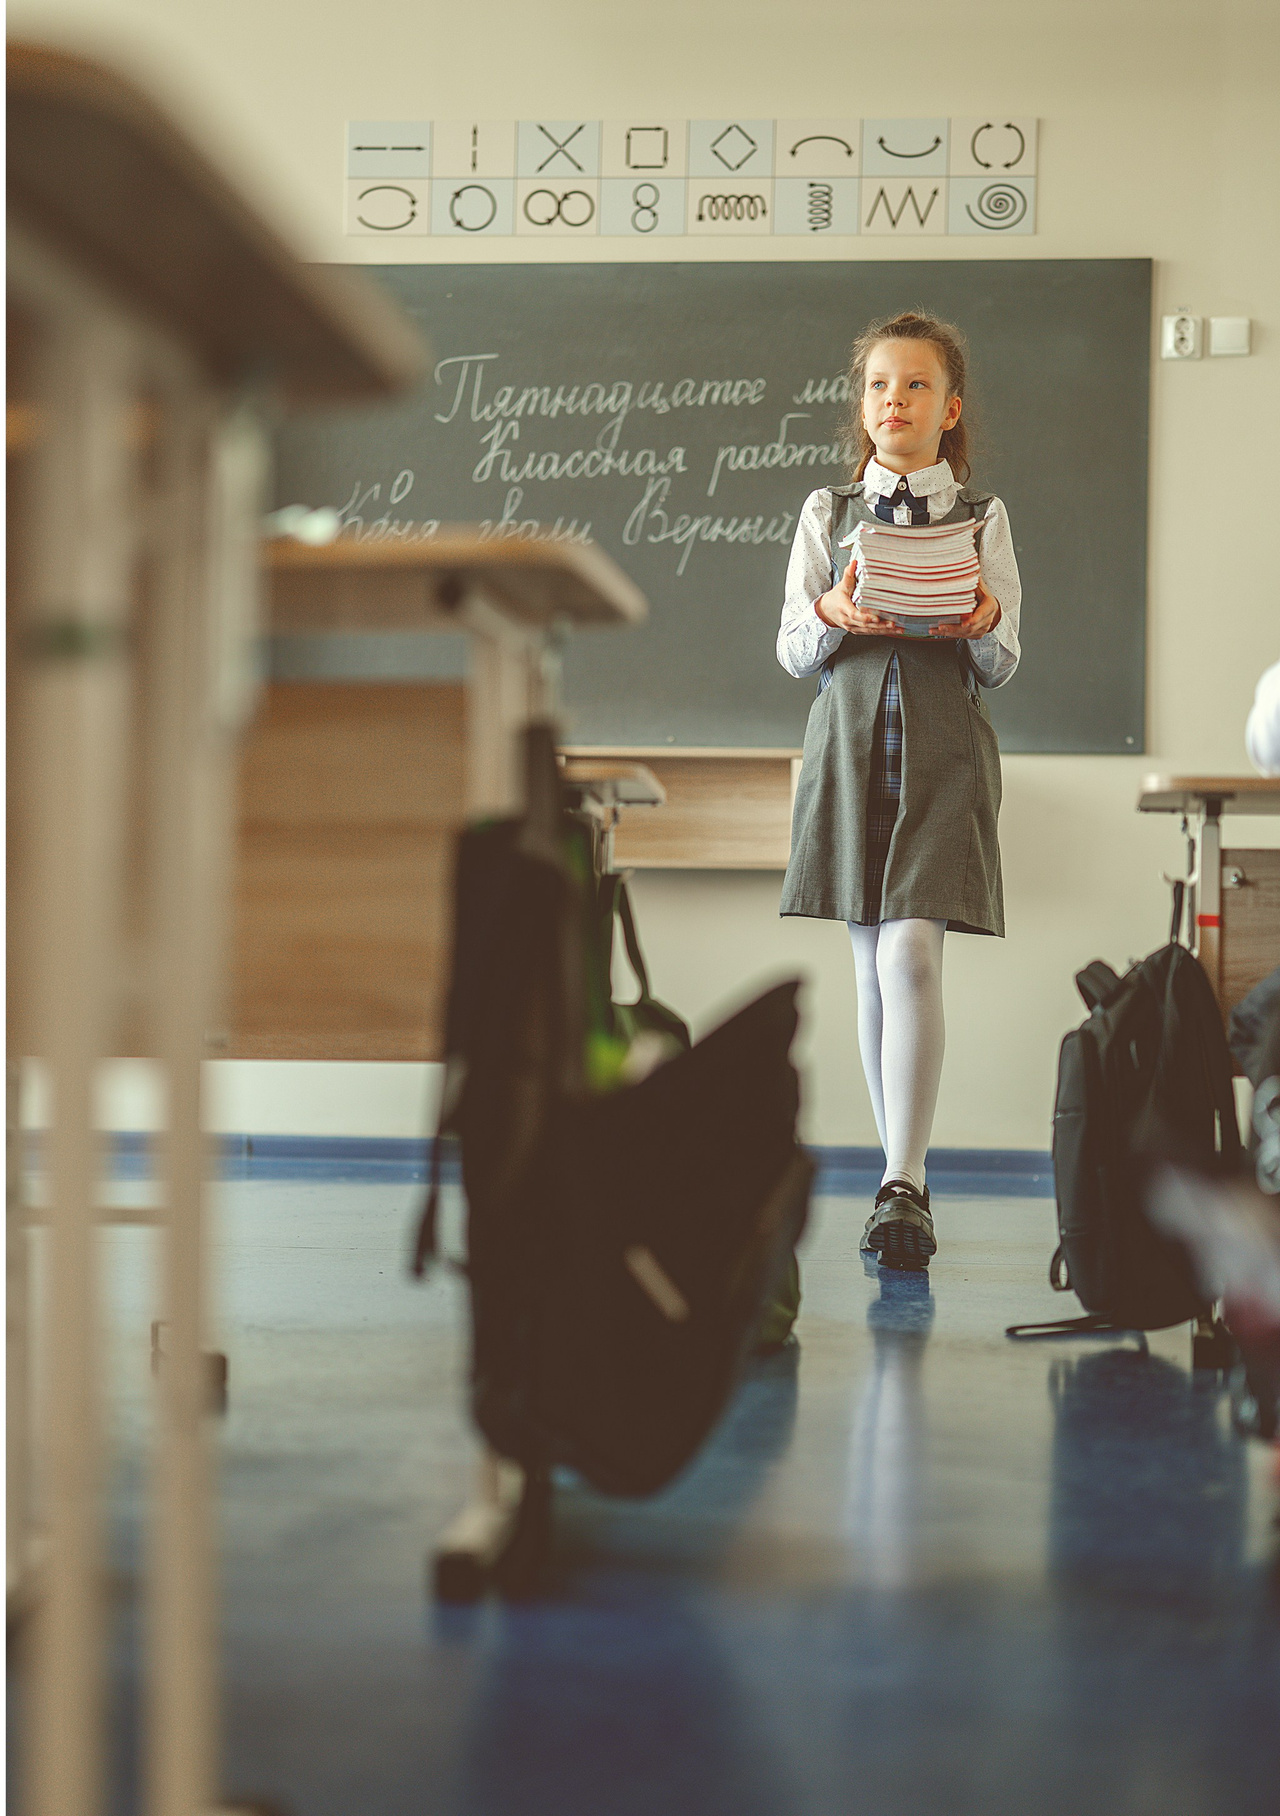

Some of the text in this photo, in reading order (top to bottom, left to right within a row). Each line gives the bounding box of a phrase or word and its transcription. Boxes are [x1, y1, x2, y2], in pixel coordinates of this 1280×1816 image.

[433, 352, 852, 453] Пятнадцатое ма
[472, 418, 688, 484] Классная
[622, 475, 797, 578] Верный
